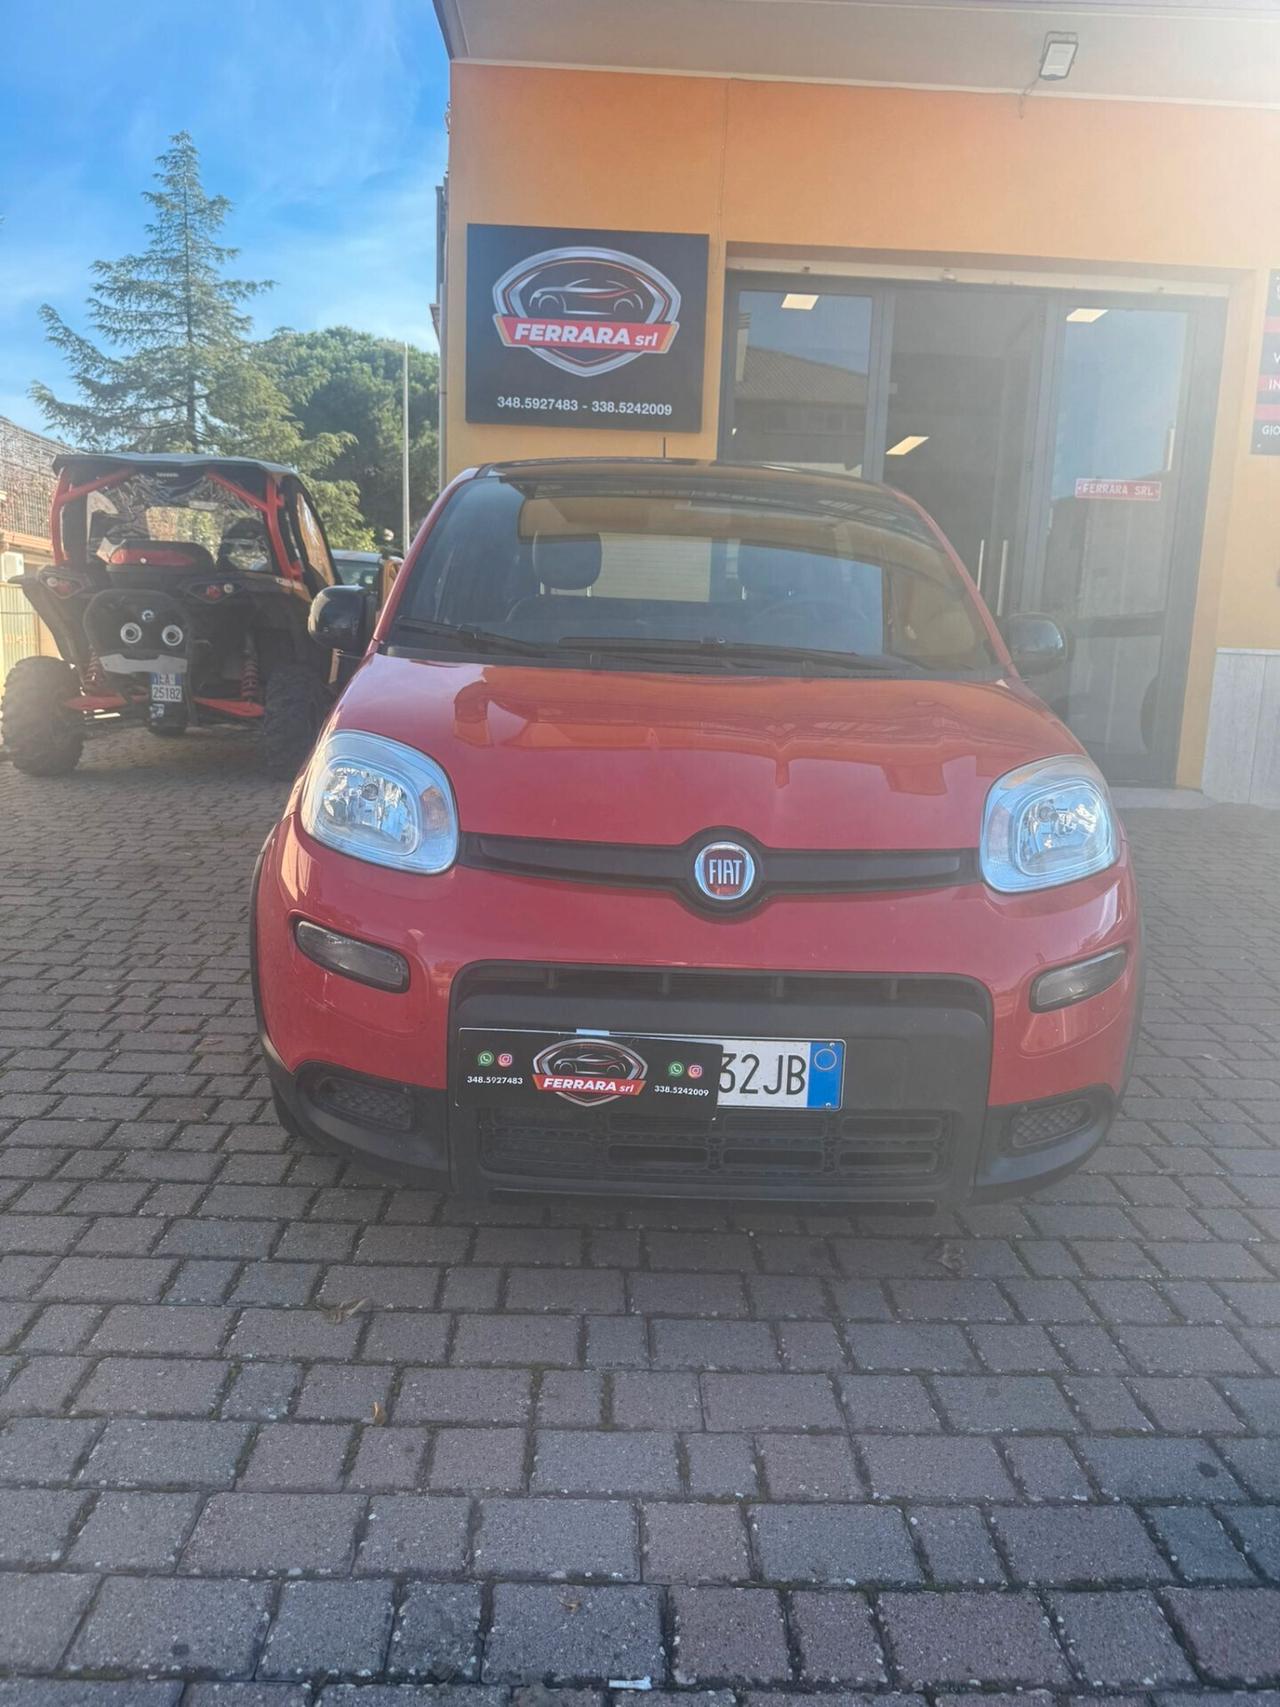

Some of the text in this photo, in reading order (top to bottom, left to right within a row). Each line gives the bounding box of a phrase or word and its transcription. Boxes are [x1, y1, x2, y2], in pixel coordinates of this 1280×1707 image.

[514, 323, 658, 346] FERRARA srl
[497, 396, 578, 411] 348.5927483
[592, 401, 672, 416] 338.5242009
[1082, 483, 1128, 495] FERRARA
[153, 686, 181, 699] 25182
[709, 859, 742, 885] FIAT
[467, 1076, 523, 1085] 348.5927483
[719, 1052, 807, 1096] 32JB
[543, 1078, 634, 1093] FERRARA srl
[654, 1085, 709, 1097] 338.5242009
